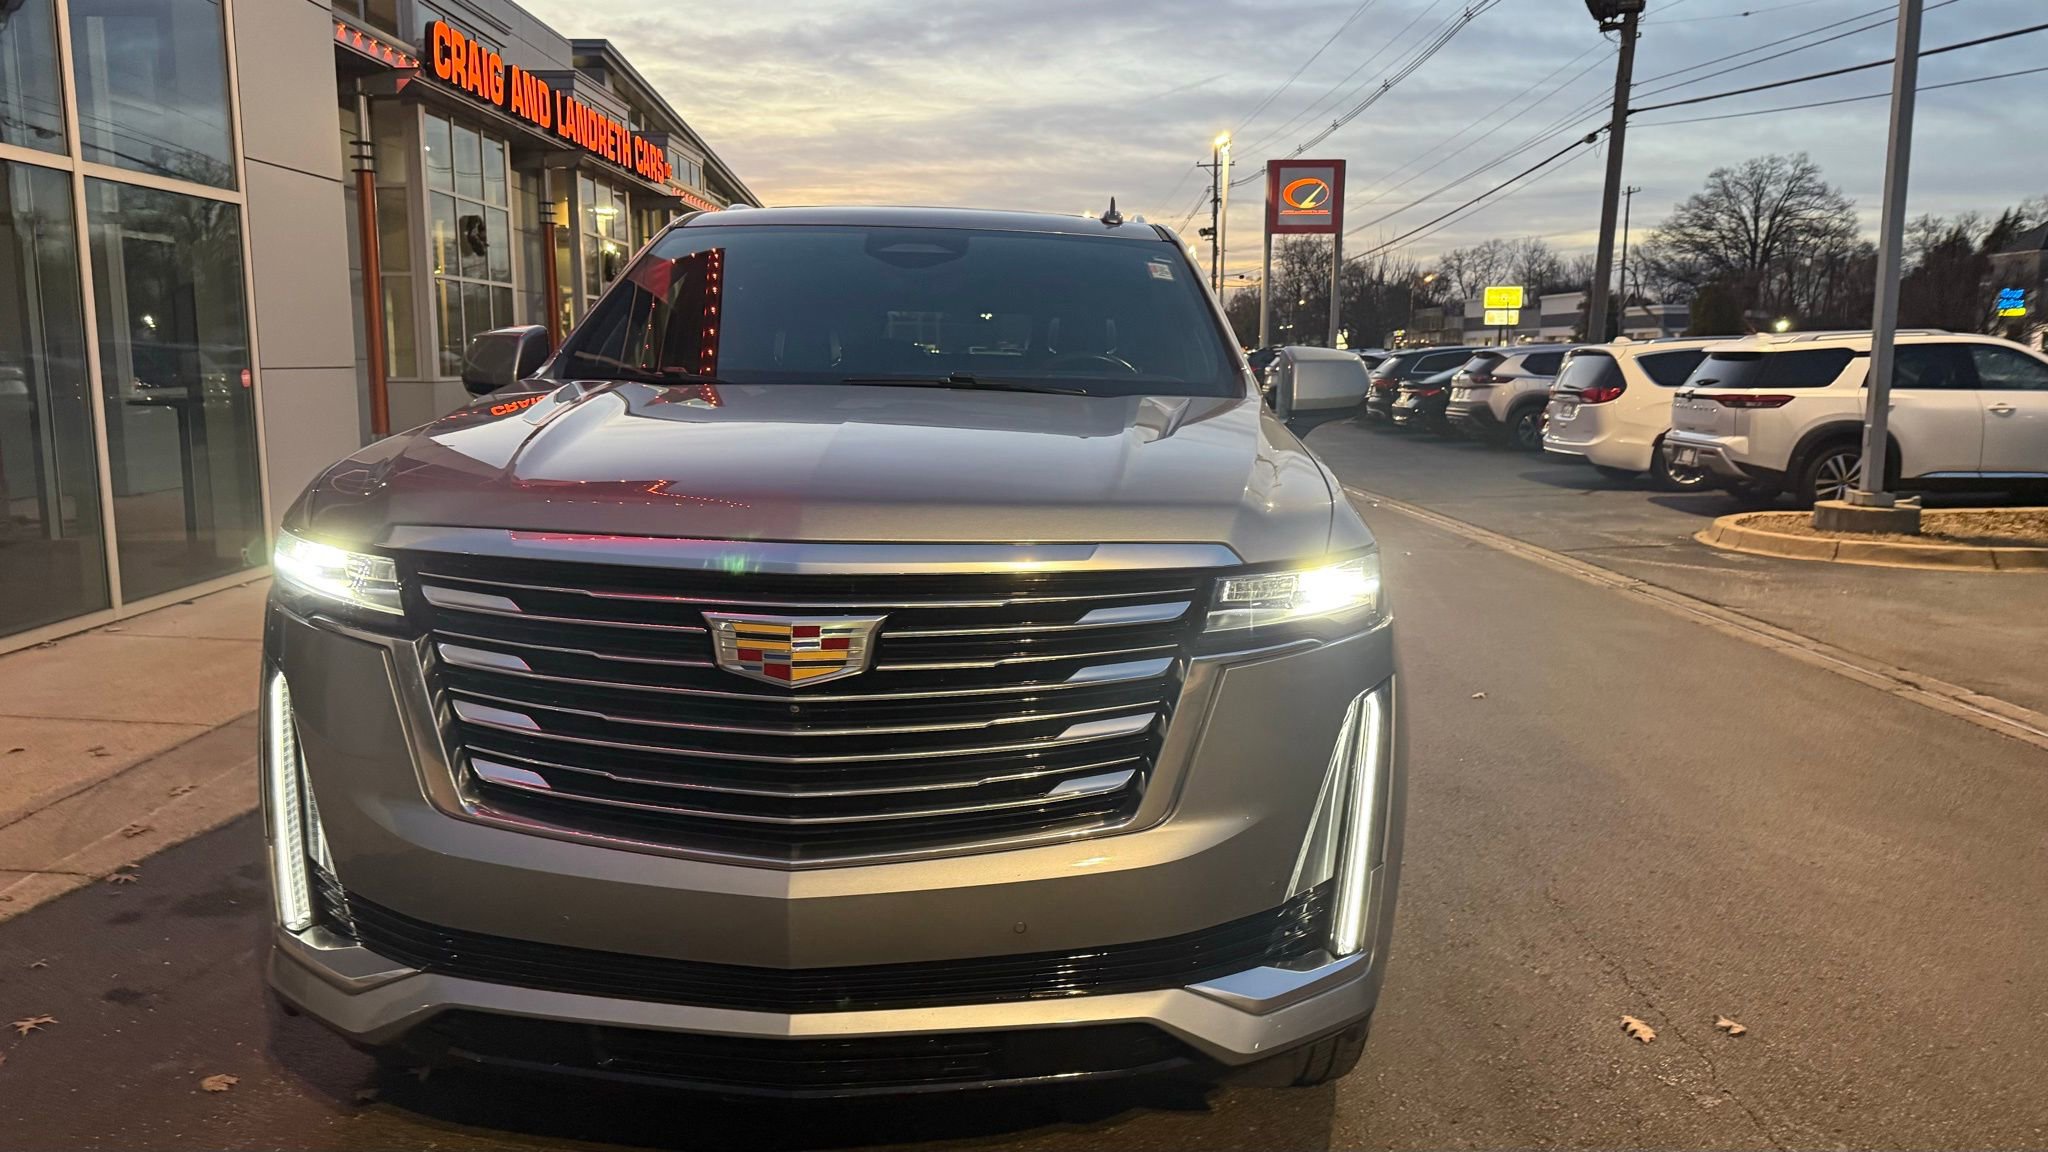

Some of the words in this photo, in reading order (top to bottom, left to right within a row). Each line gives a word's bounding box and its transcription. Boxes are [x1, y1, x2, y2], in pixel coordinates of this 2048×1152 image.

[433, 20, 504, 106] CRAIG
[511, 65, 551, 129] AND
[556, 90, 632, 168] LANDRETH
[634, 135, 665, 184] CARS
